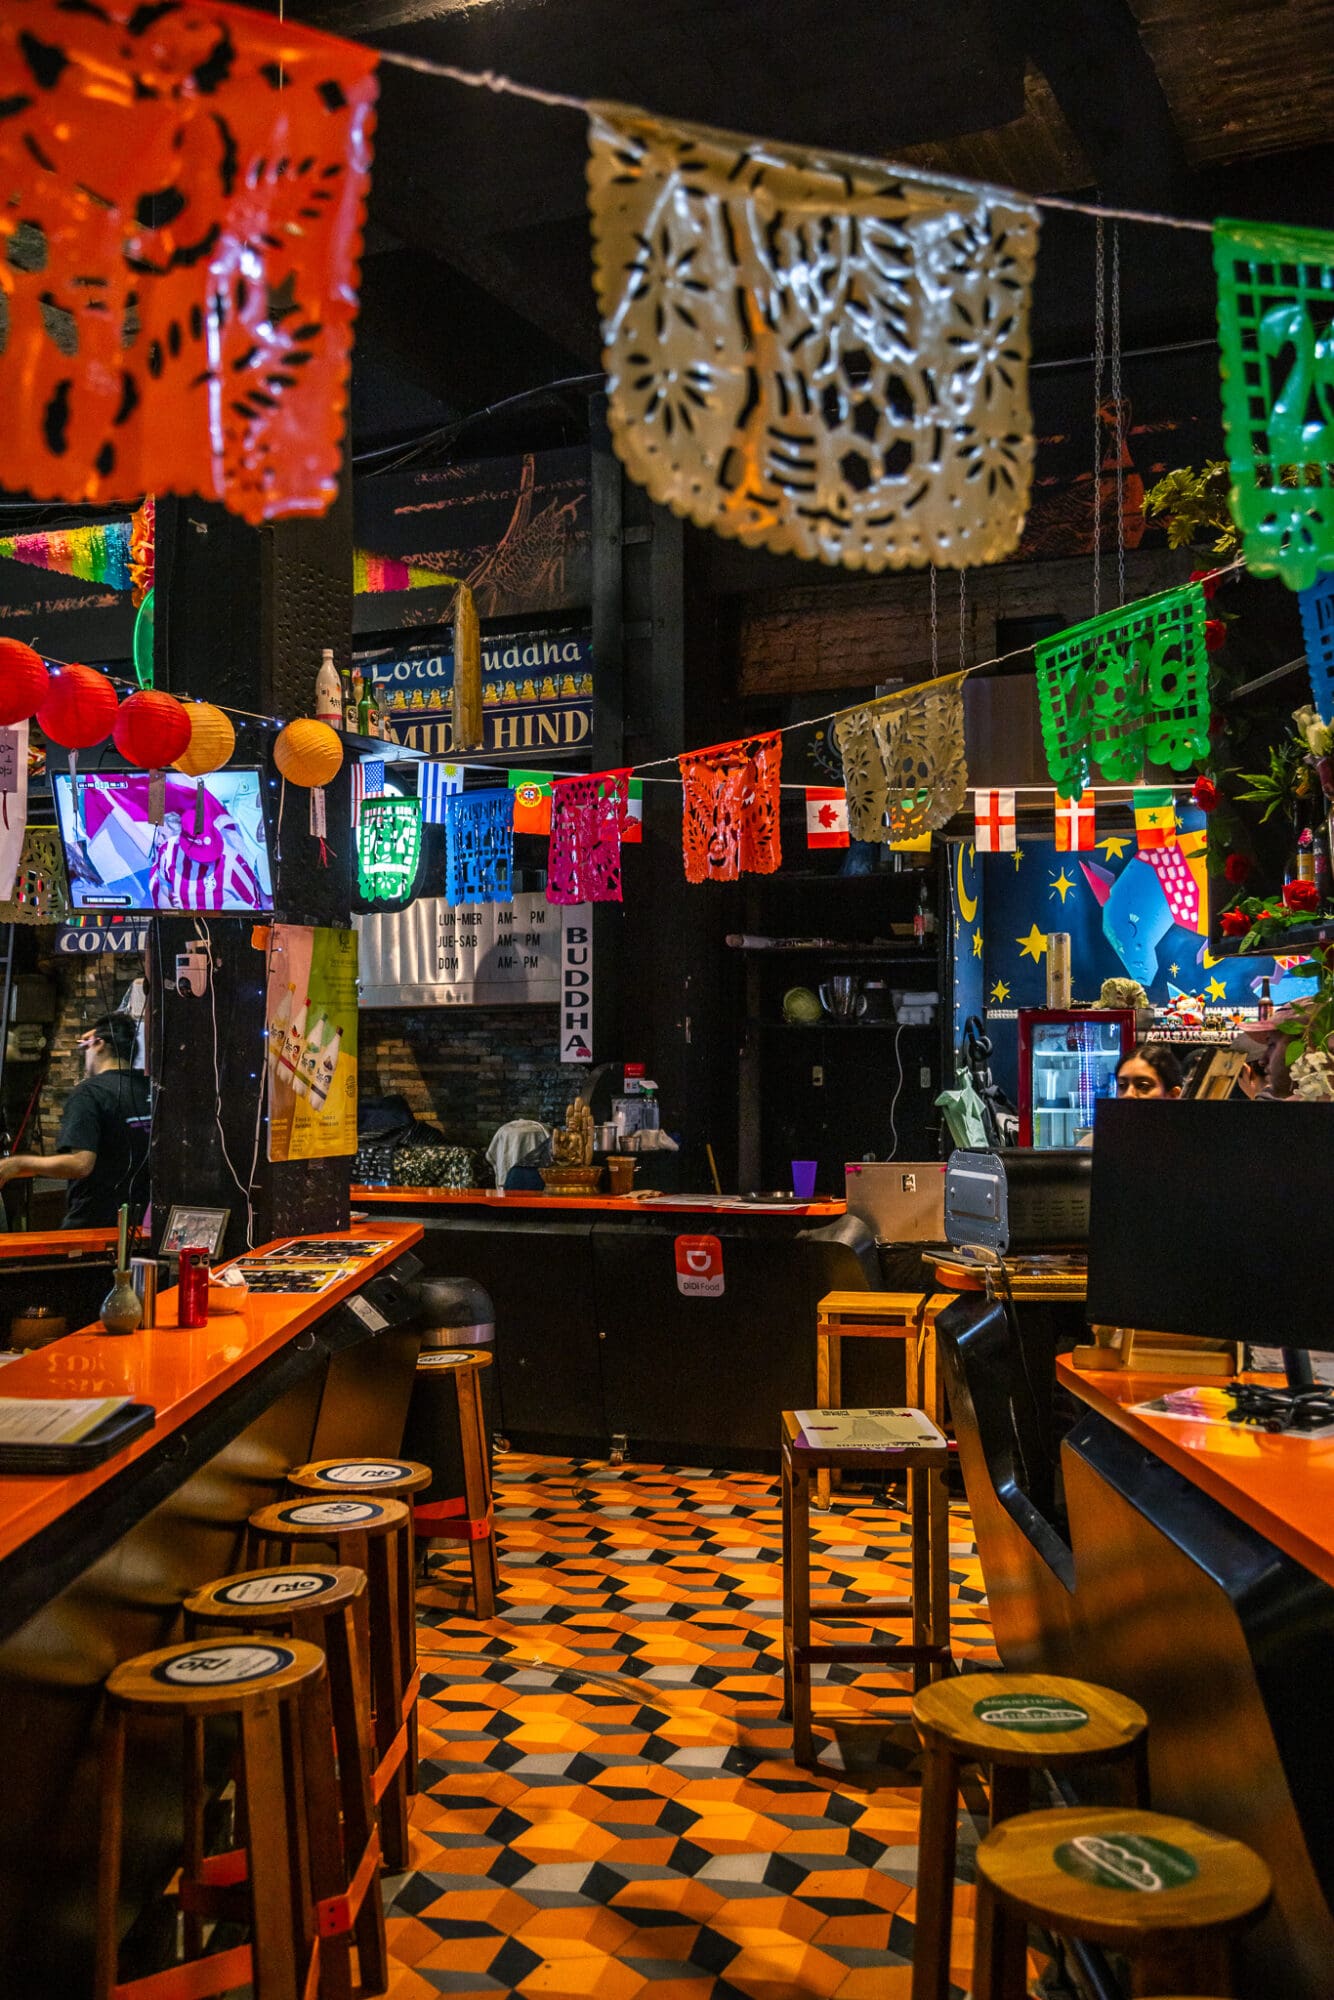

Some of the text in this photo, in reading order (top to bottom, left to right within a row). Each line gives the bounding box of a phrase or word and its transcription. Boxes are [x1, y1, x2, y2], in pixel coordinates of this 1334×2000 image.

[492, 708, 594, 749] HIND
[438, 910, 545, 926] LUN-MIER AM- PM
[438, 933, 541, 948] JUE-SAB AM- PM
[438, 955, 538, 970] DOM AM- PM
[565, 926, 590, 1052] BUDDHA
[700, 1282, 720, 1291] Food
